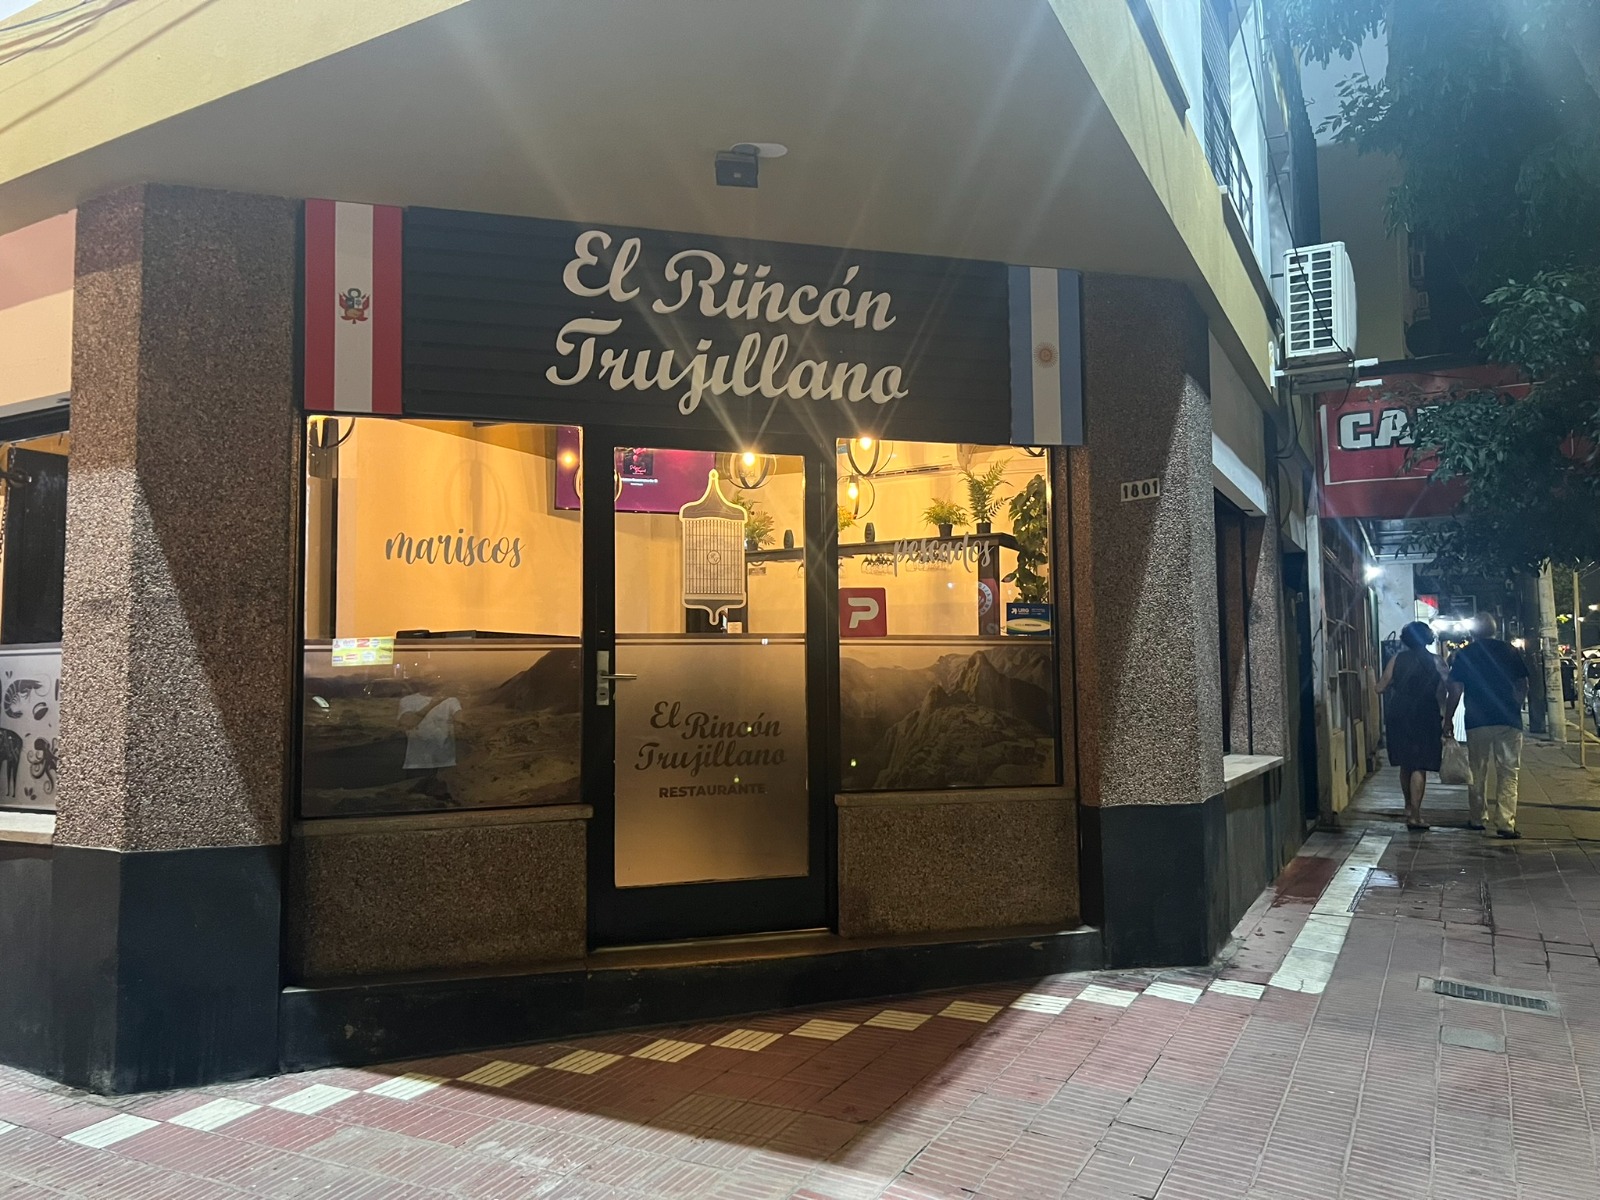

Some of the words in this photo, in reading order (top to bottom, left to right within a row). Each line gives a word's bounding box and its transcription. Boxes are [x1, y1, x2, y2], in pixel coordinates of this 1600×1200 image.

[563, 230, 641, 302] El
[545, 317, 909, 415] Trujillano
[1123, 480, 1158, 499] 1801
[385, 528, 526, 567] mariscos
[893, 531, 994, 577] pescados
[650, 701, 681, 728] El
[681, 712, 782, 739] Rincón
[634, 740, 787, 777] Trujillano
[658, 784, 766, 798] RESTAURANTE
